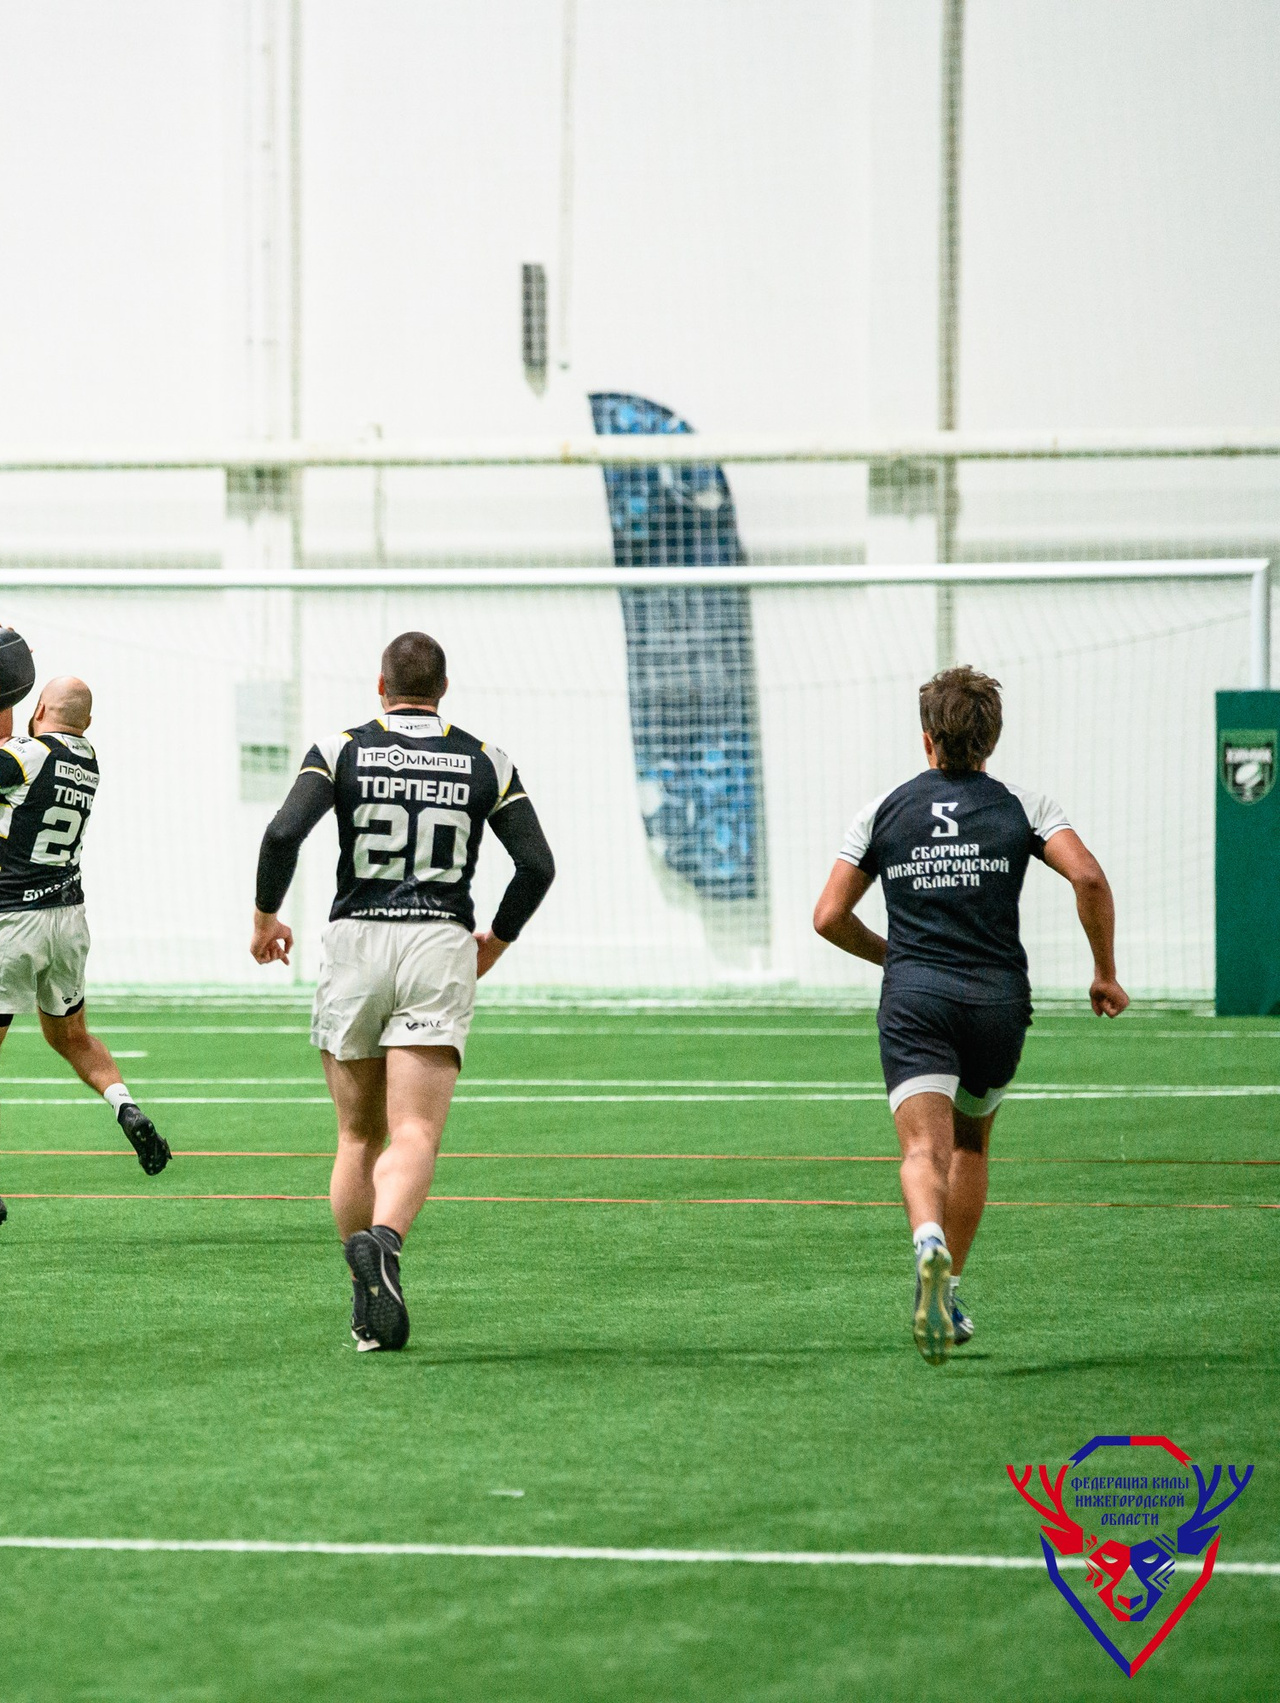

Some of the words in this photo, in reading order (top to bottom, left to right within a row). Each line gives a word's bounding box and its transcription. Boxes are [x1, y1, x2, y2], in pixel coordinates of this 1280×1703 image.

[362, 747, 467, 769] ПРОММАШ
[357, 776, 470, 806] ТОРПЕДО
[931, 802, 959, 838] 5
[353, 803, 471, 884] 20
[911, 843, 980, 860] СБОРНАЯ
[886, 857, 1010, 880] НИЖЕГОРОДСКОЙ
[912, 874, 980, 890] ОБЛАСТИ
